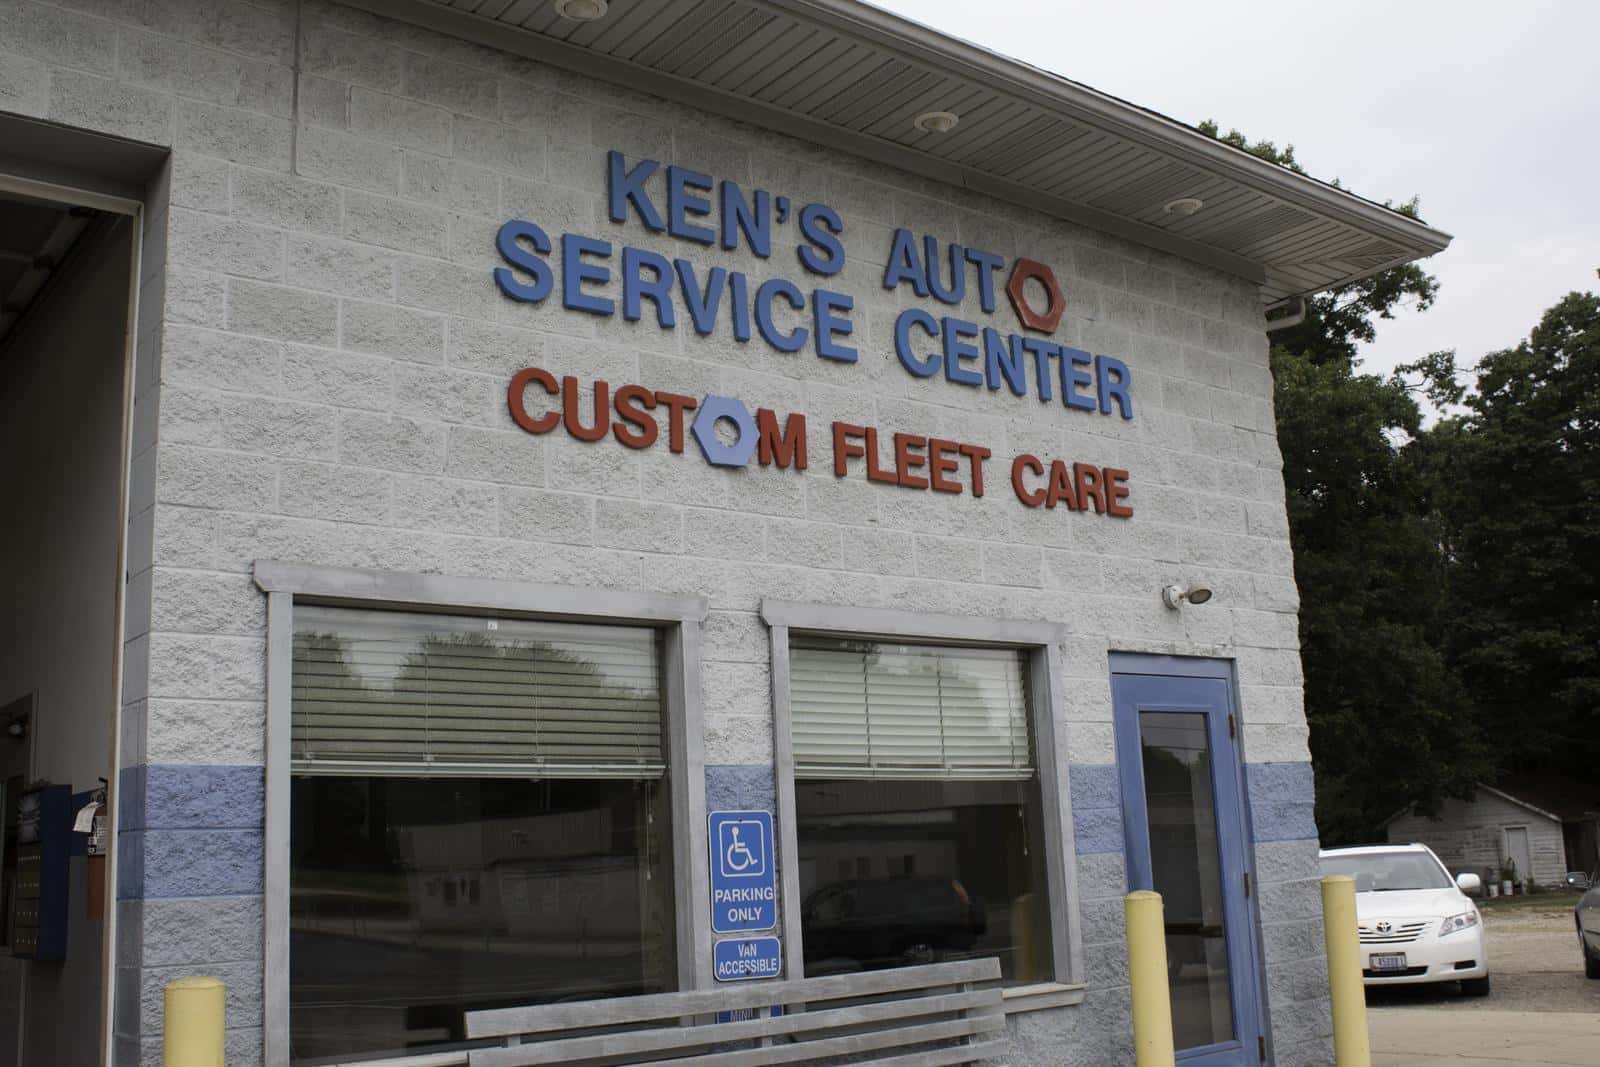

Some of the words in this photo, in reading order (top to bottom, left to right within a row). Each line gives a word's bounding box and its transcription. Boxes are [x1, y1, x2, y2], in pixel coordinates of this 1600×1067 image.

[607, 150, 846, 277] KEN'S
[883, 227, 1066, 334] AUTO
[494, 219, 858, 362] SERVICE
[894, 308, 1133, 421] CENTER
[507, 368, 807, 471] CUSTOM
[832, 421, 991, 498] FLEET
[1011, 453, 1134, 518] CARE
[714, 887, 774, 903] PARKING
[727, 907, 762, 922] ONLY
[738, 943, 757, 957] VAN
[718, 958, 777, 975] ACCESSIBLE
